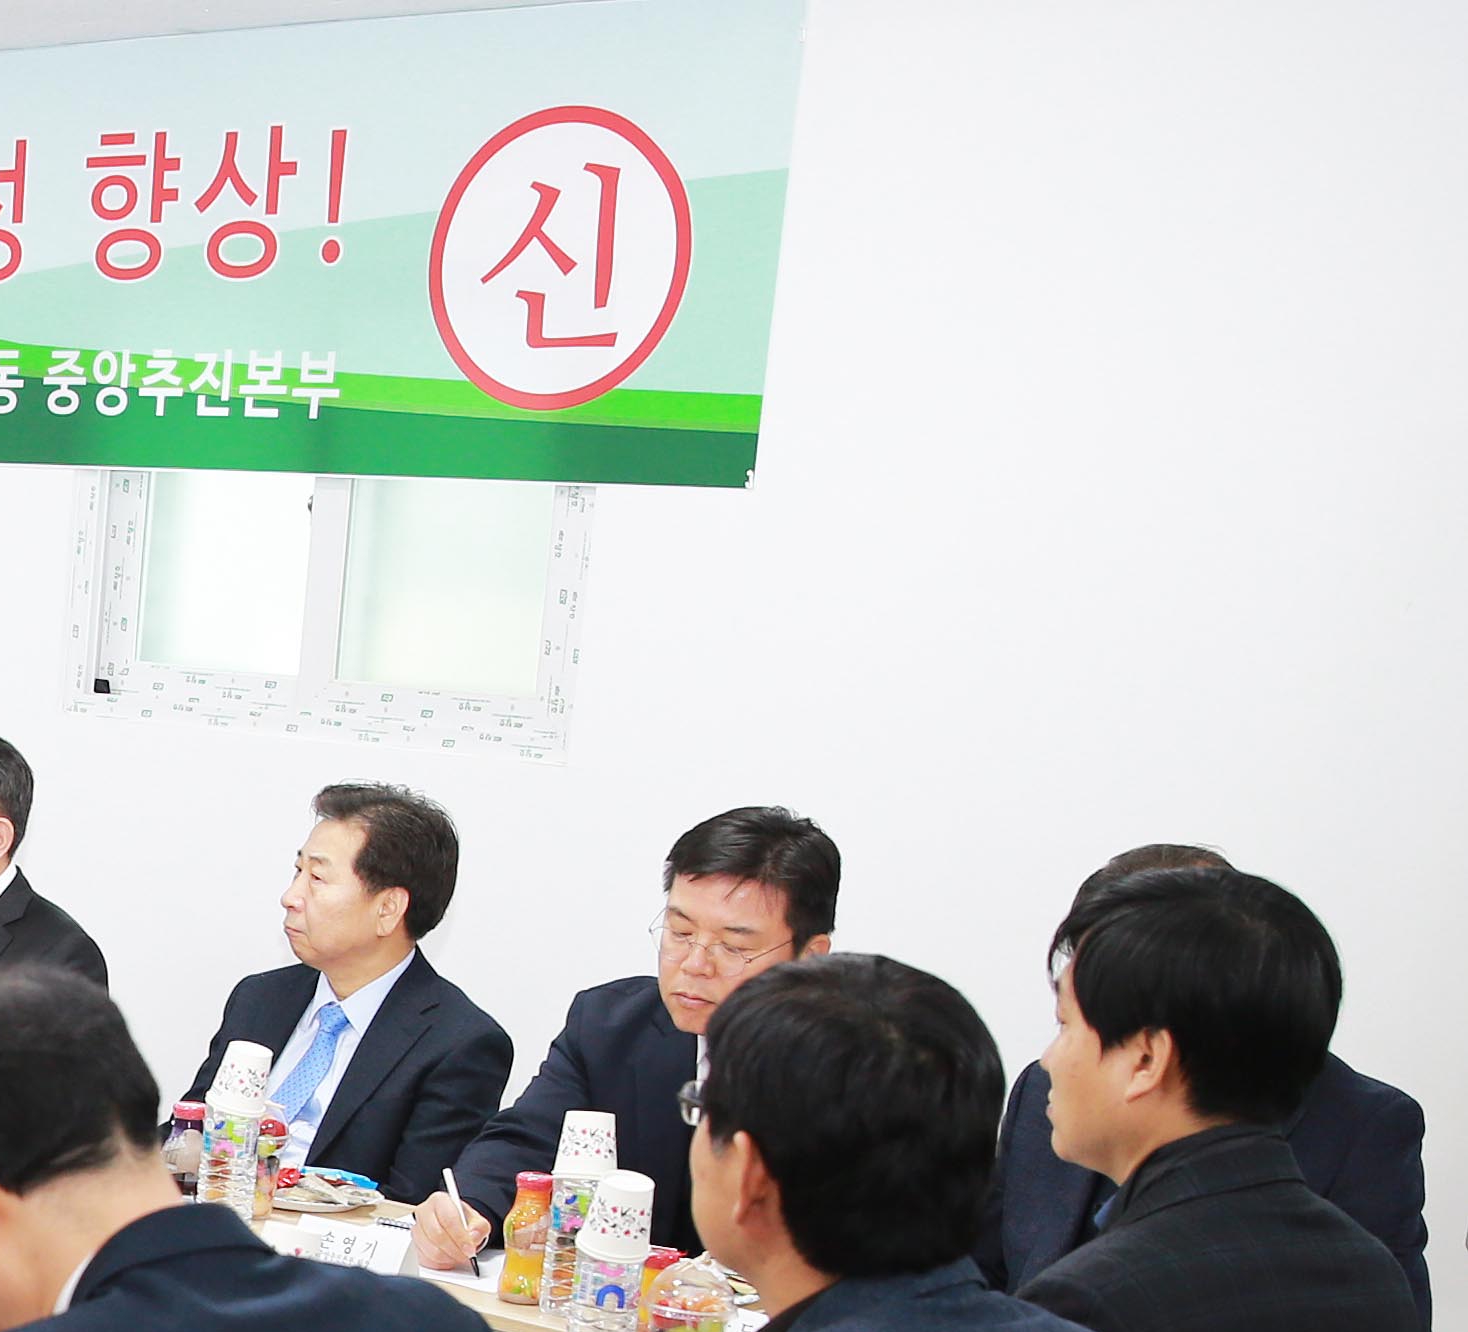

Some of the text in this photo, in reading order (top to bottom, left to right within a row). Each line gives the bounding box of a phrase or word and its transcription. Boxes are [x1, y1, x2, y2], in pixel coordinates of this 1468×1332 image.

[82, 124, 352, 284] 향상!
[479, 163, 624, 350] 신
[42, 350, 342, 422] 중앙추진본부
[320, 1231, 378, 1258] 손영기
